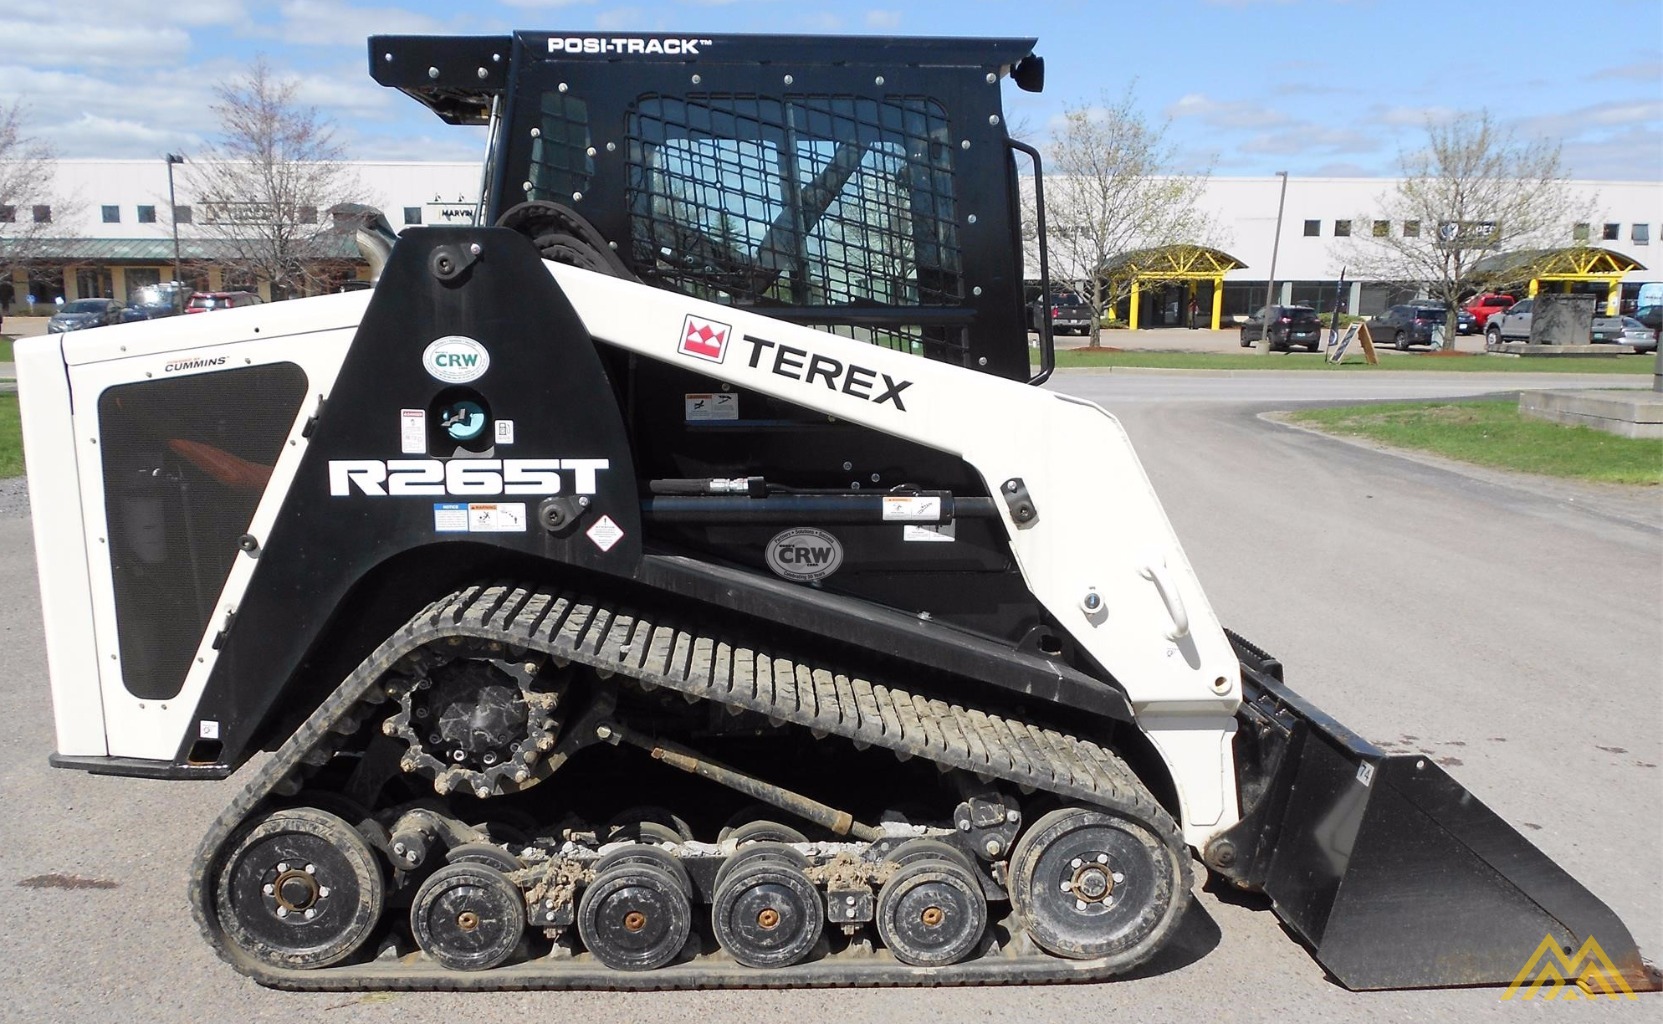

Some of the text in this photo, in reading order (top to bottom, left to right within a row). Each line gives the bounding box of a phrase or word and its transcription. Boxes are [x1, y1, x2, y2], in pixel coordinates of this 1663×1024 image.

[441, 209, 473, 217] MARVIN
[164, 356, 227, 372] CUMMINS
[435, 353, 478, 367] CRW
[743, 334, 914, 412] TEREX
[328, 458, 610, 496] R265T
[778, 547, 832, 563] CRW
